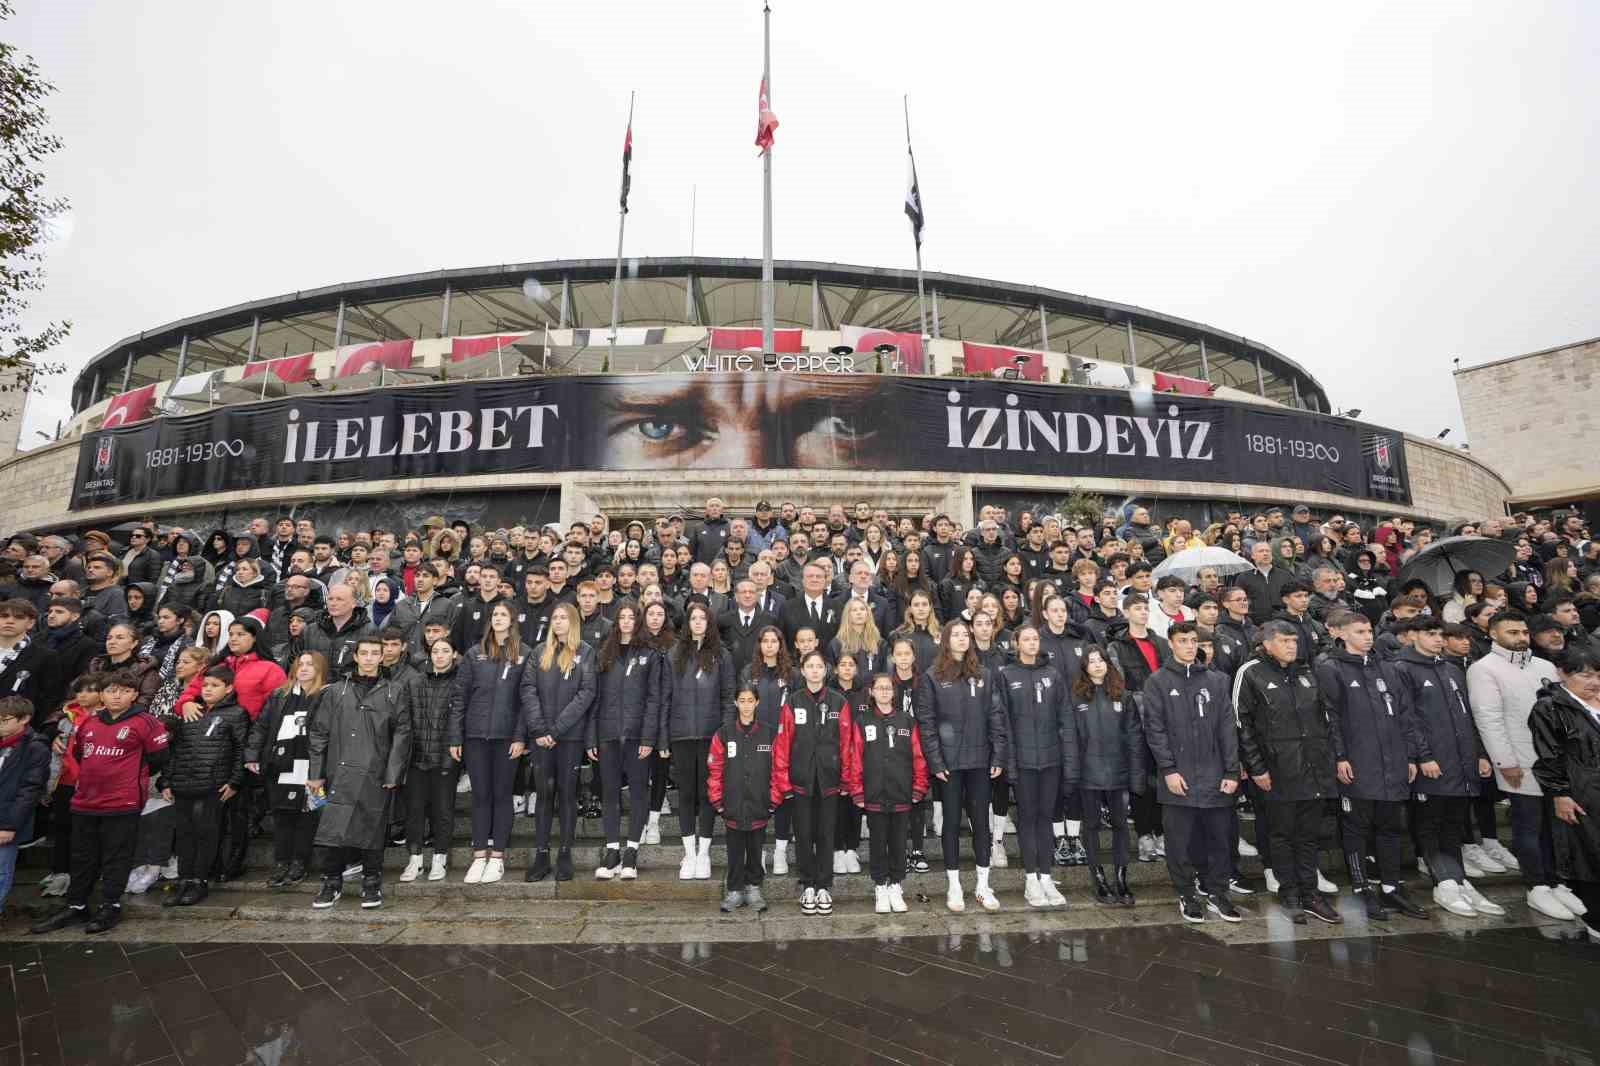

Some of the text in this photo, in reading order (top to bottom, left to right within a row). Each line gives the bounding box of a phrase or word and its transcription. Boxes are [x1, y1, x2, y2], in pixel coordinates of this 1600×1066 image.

[682, 353, 753, 373] WHITE
[283, 404, 559, 464] İLELEBET
[946, 389, 1213, 460] İZİNDEYİZ
[794, 708, 807, 724] B
[95, 745, 124, 756] Rain
